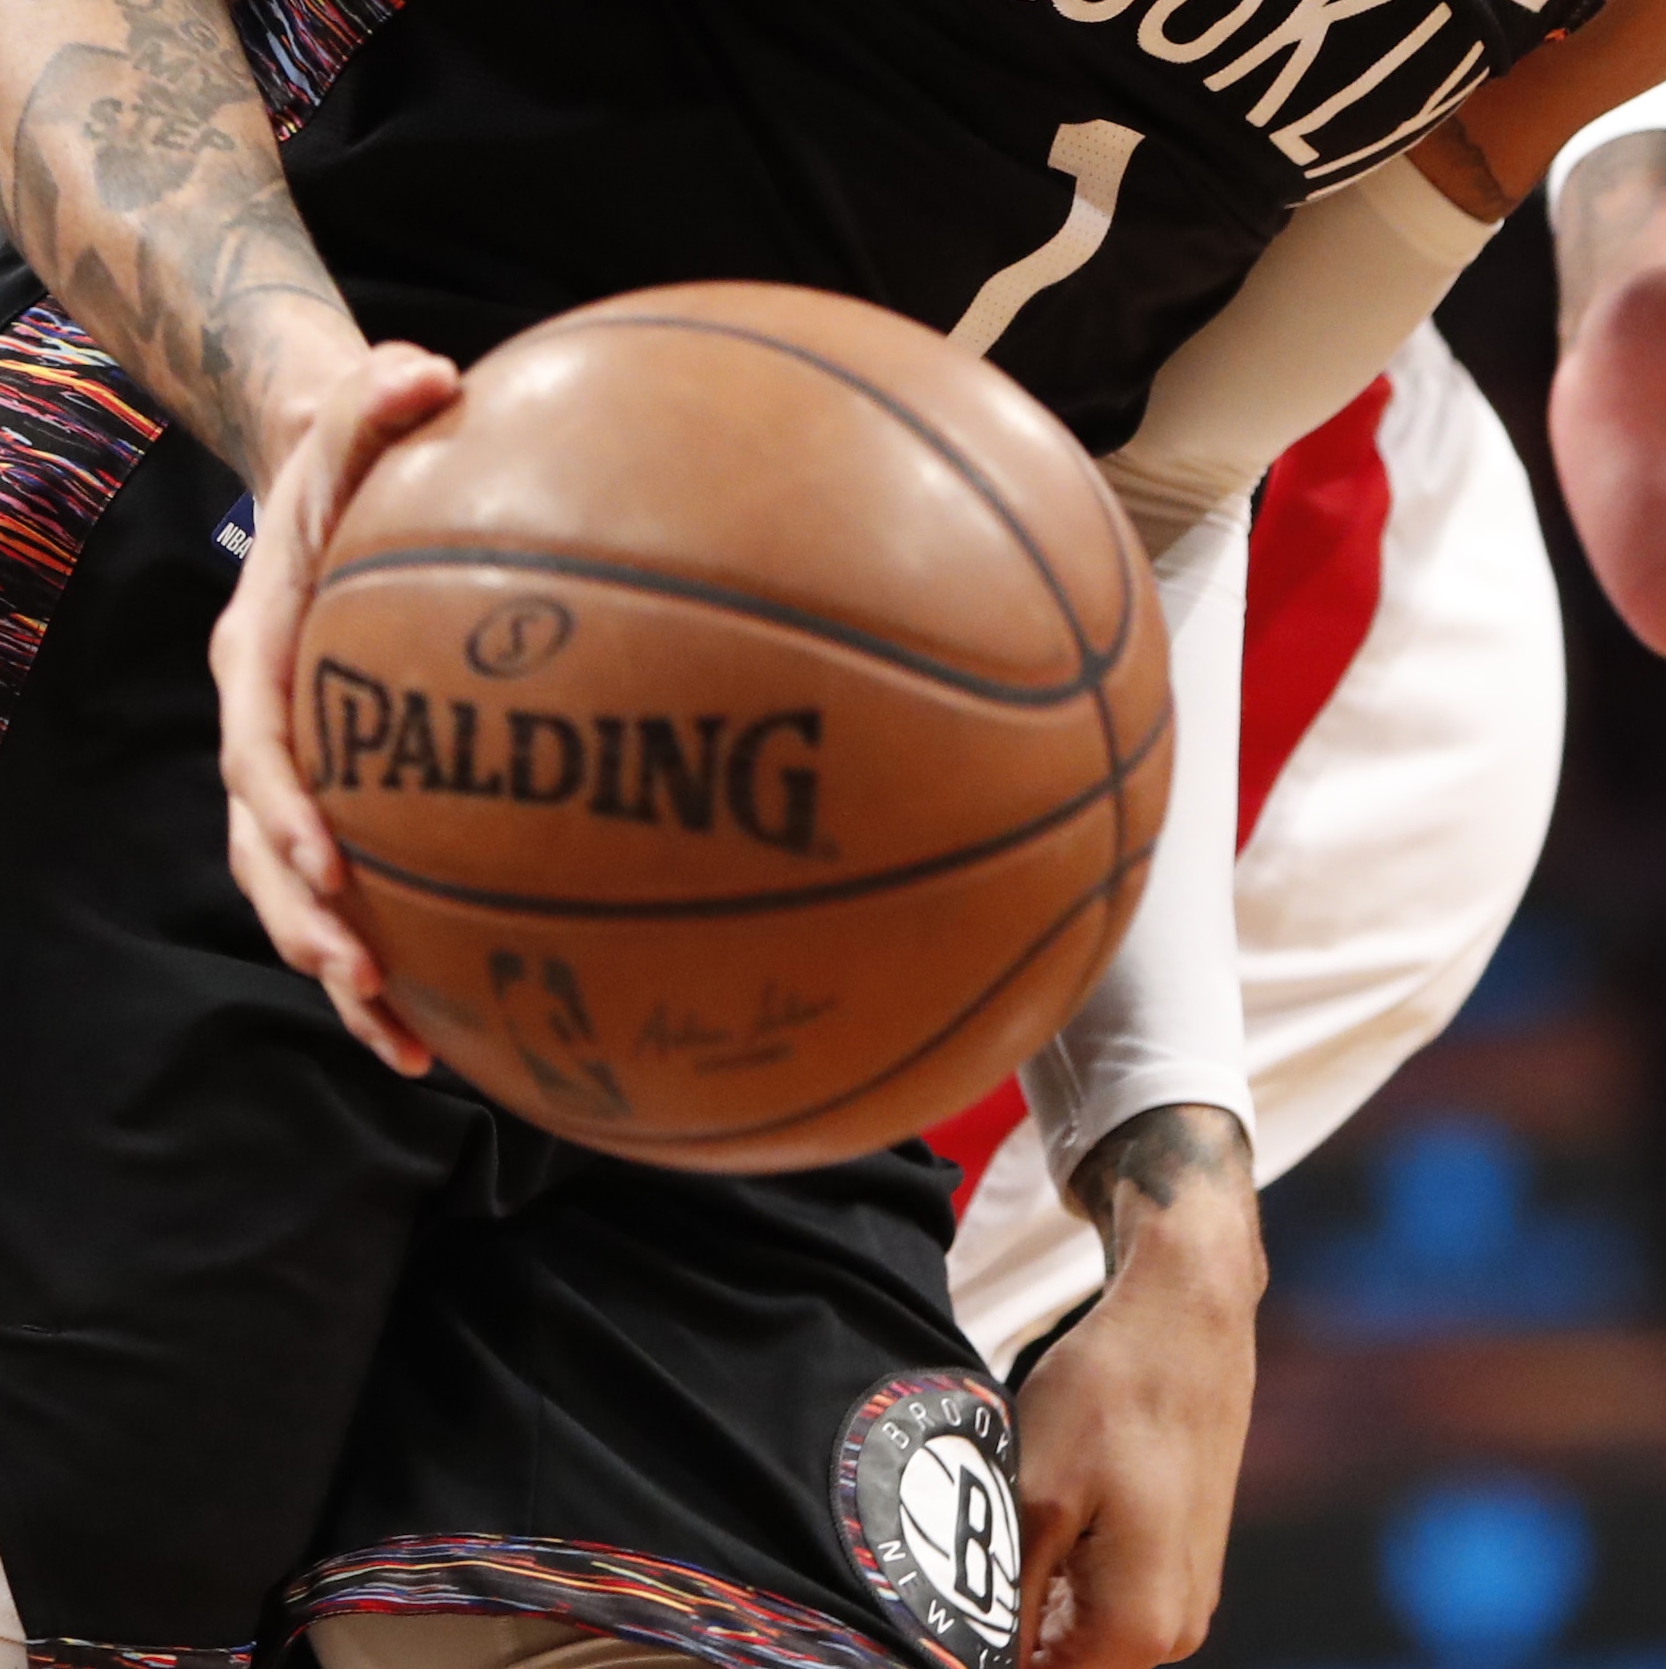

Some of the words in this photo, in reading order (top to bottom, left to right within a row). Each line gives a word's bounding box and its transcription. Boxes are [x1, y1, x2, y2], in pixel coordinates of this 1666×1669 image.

[945, 118, 1145, 360] 1
[215, 521, 254, 560] NBA
[312, 657, 823, 856] SPALDING
